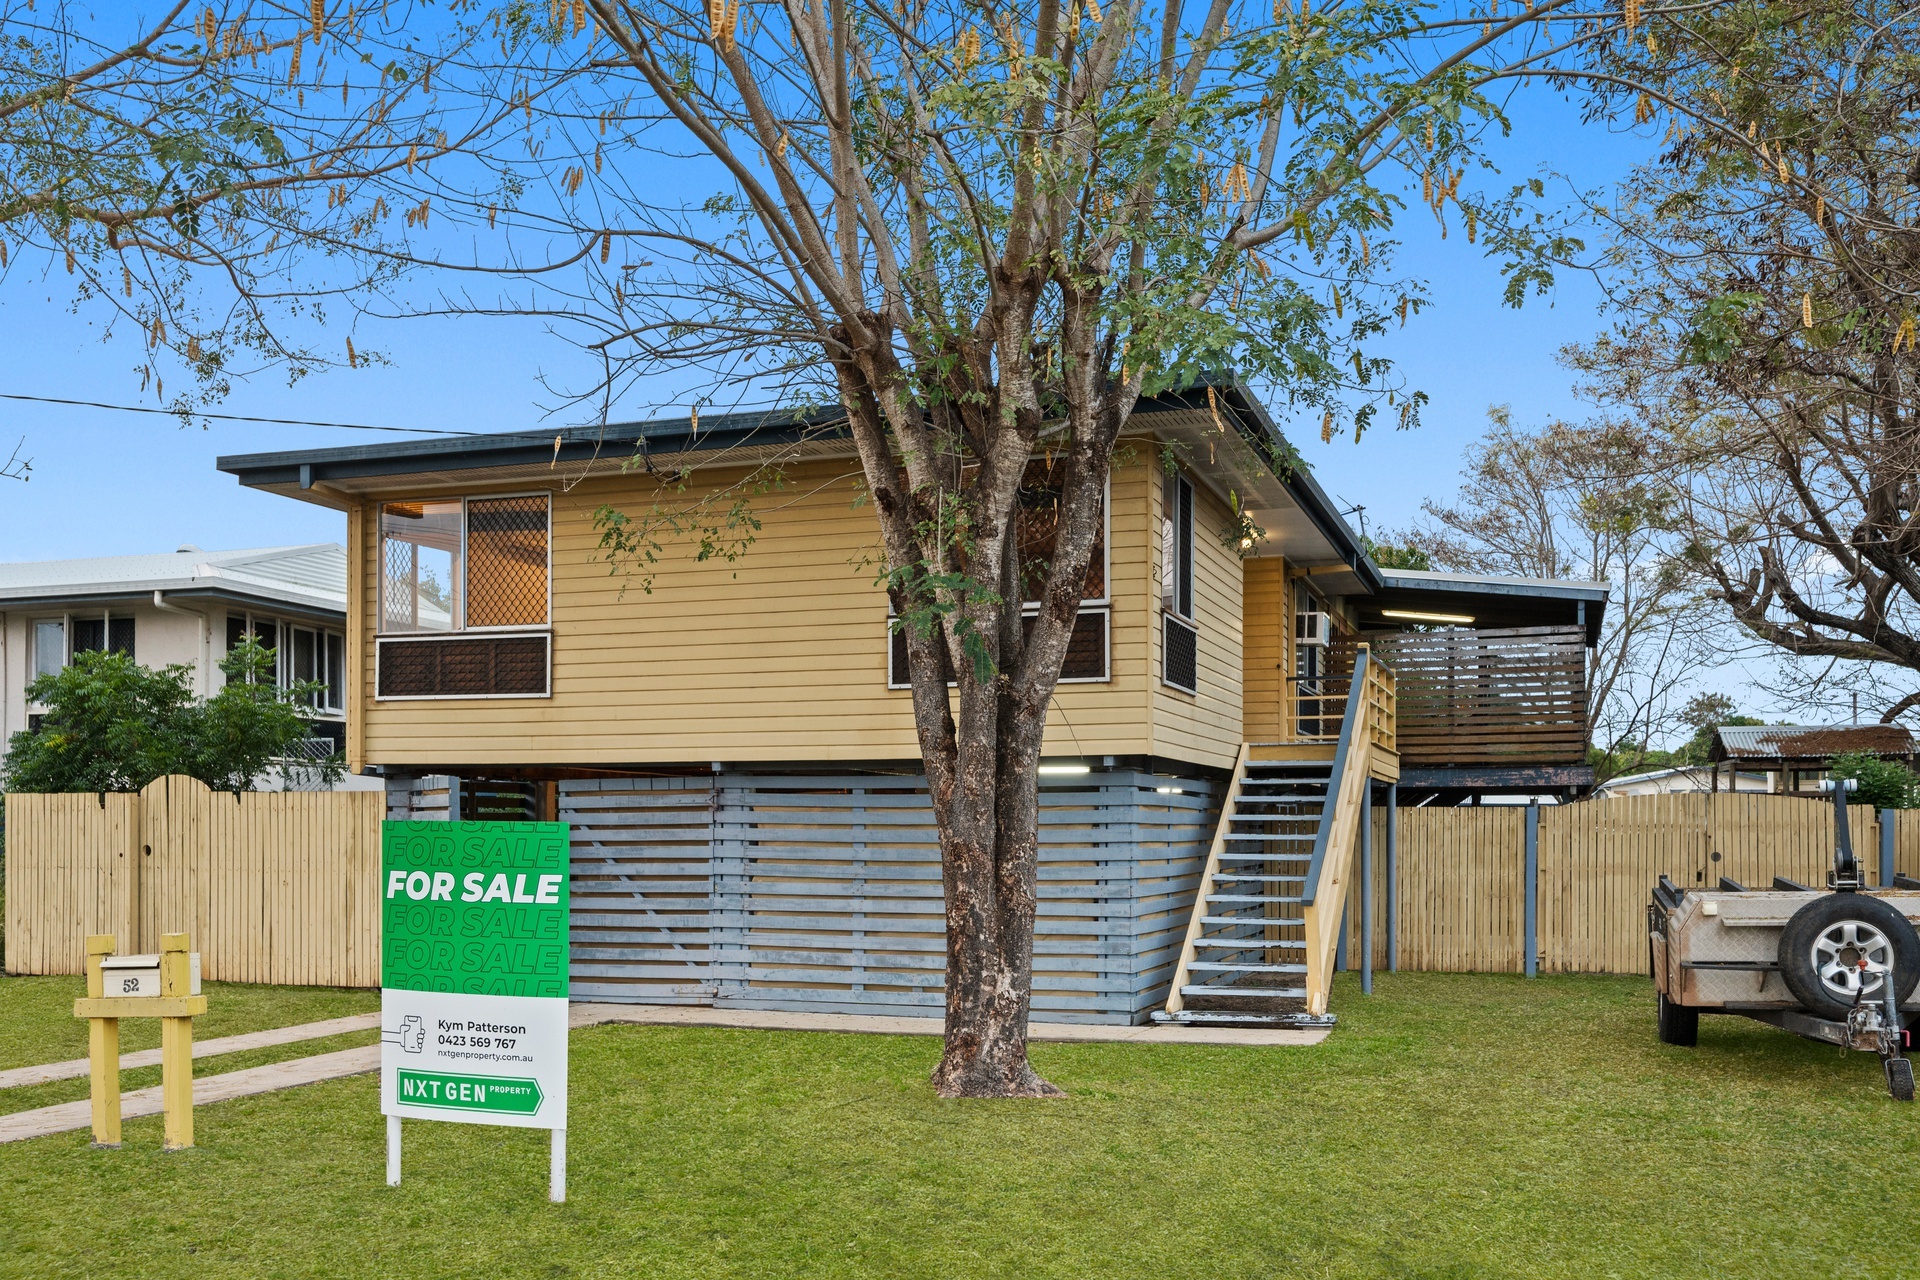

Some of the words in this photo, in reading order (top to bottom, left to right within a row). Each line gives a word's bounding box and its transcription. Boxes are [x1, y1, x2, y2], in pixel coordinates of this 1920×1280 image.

[386, 836, 456, 867] FOR
[460, 836, 563, 869] SALE
[386, 870, 456, 901] FOR
[460, 872, 563, 904] SALE
[386, 904, 456, 937] FOR
[460, 907, 563, 939] SALE
[386, 938, 456, 971] FOR
[460, 942, 563, 975] SALE
[123, 977, 140, 993] 52
[438, 1019, 464, 1032] Kym
[467, 1021, 526, 1035] Patterson
[438, 1034, 466, 1047] 0423
[470, 1036, 491, 1048] 569
[494, 1038, 516, 1049] 767
[437, 1049, 533, 1063] nxtgenproperty.com.au
[403, 1078, 441, 1099] NXT
[445, 1082, 486, 1103] GEN
[489, 1085, 532, 1095] PROPERTY
